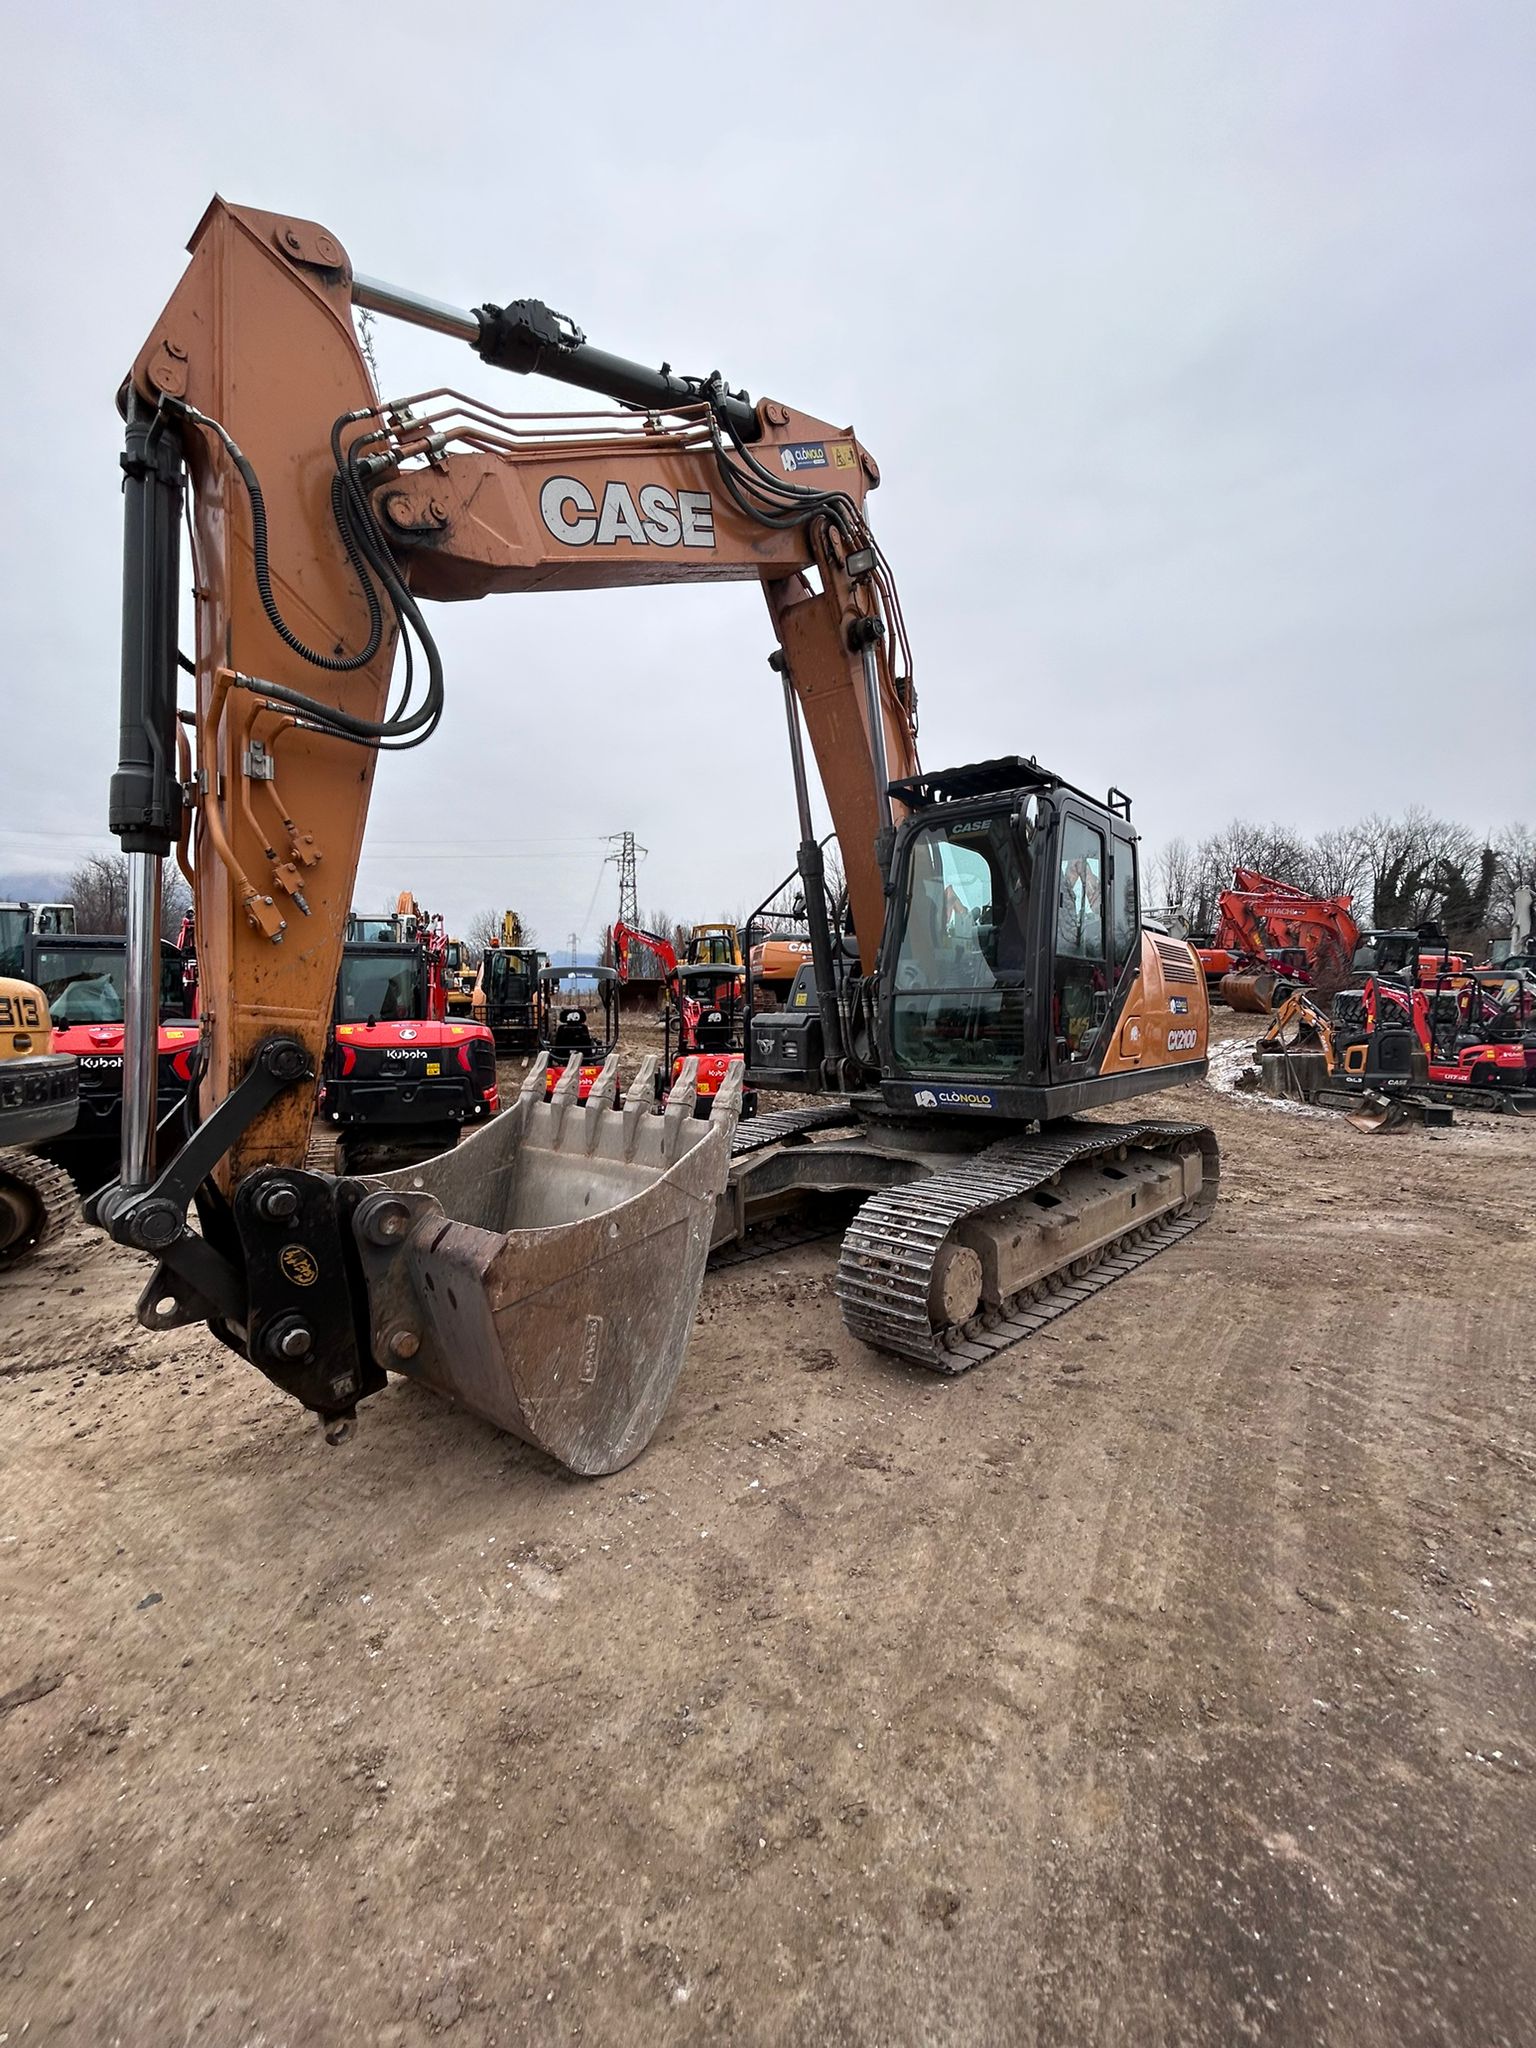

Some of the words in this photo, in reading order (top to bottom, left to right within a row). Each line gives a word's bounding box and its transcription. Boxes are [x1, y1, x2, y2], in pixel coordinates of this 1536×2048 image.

[540, 475, 716, 547] CASE
[952, 819, 992, 834] CASE
[386, 1050, 428, 1059] Kubota
[80, 1057, 124, 1068] Kubot
[939, 1091, 991, 1104] CLÒNOLO
